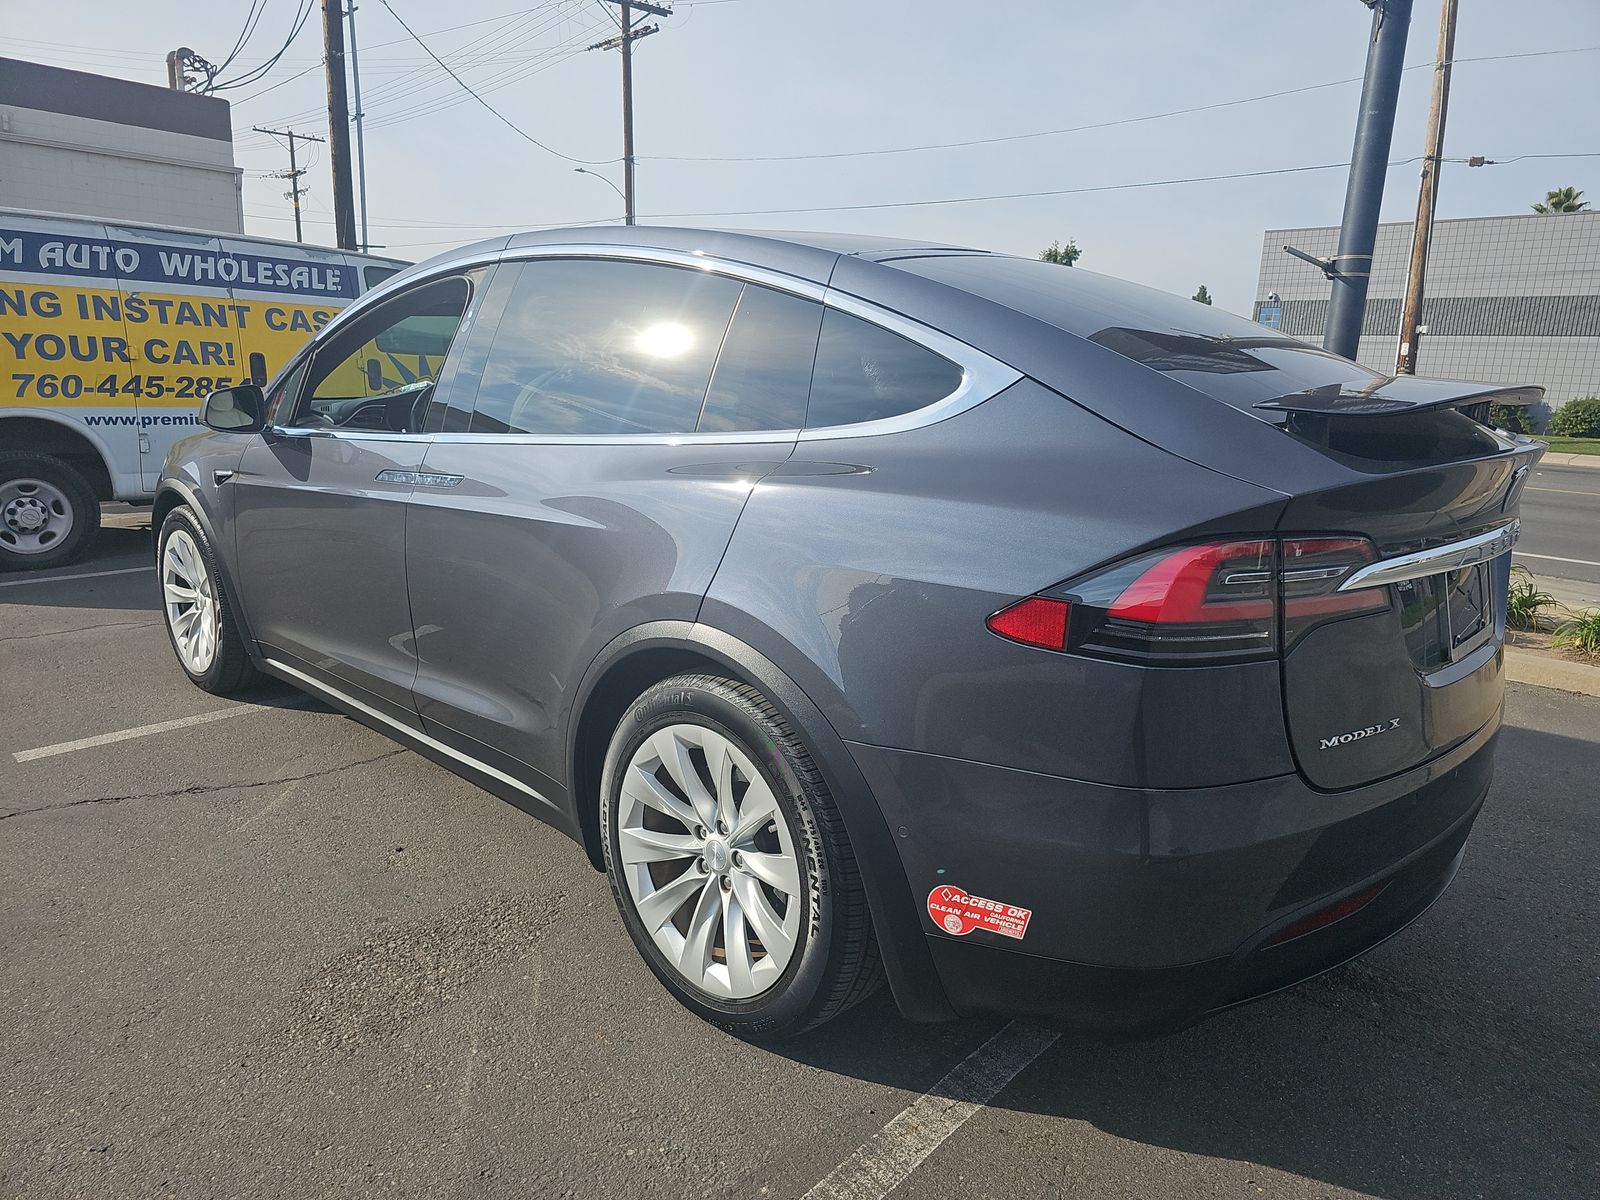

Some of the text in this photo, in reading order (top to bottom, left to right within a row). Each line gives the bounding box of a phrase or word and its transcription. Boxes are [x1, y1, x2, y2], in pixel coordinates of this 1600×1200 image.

[39, 241, 140, 274] AUTO
[158, 251, 342, 291] WHOLESALE
[76, 293, 251, 329] INSTANT
[264, 307, 341, 333] CAS
[2, 332, 236, 366] YOUR CAR!
[1320, 718, 1400, 750] MODEL X
[930, 902, 1025, 931] CLEAN AIR VEHICLE
[951, 894, 1028, 920] ACCESS OK
[989, 911, 1025, 925] CALIFORNIA
